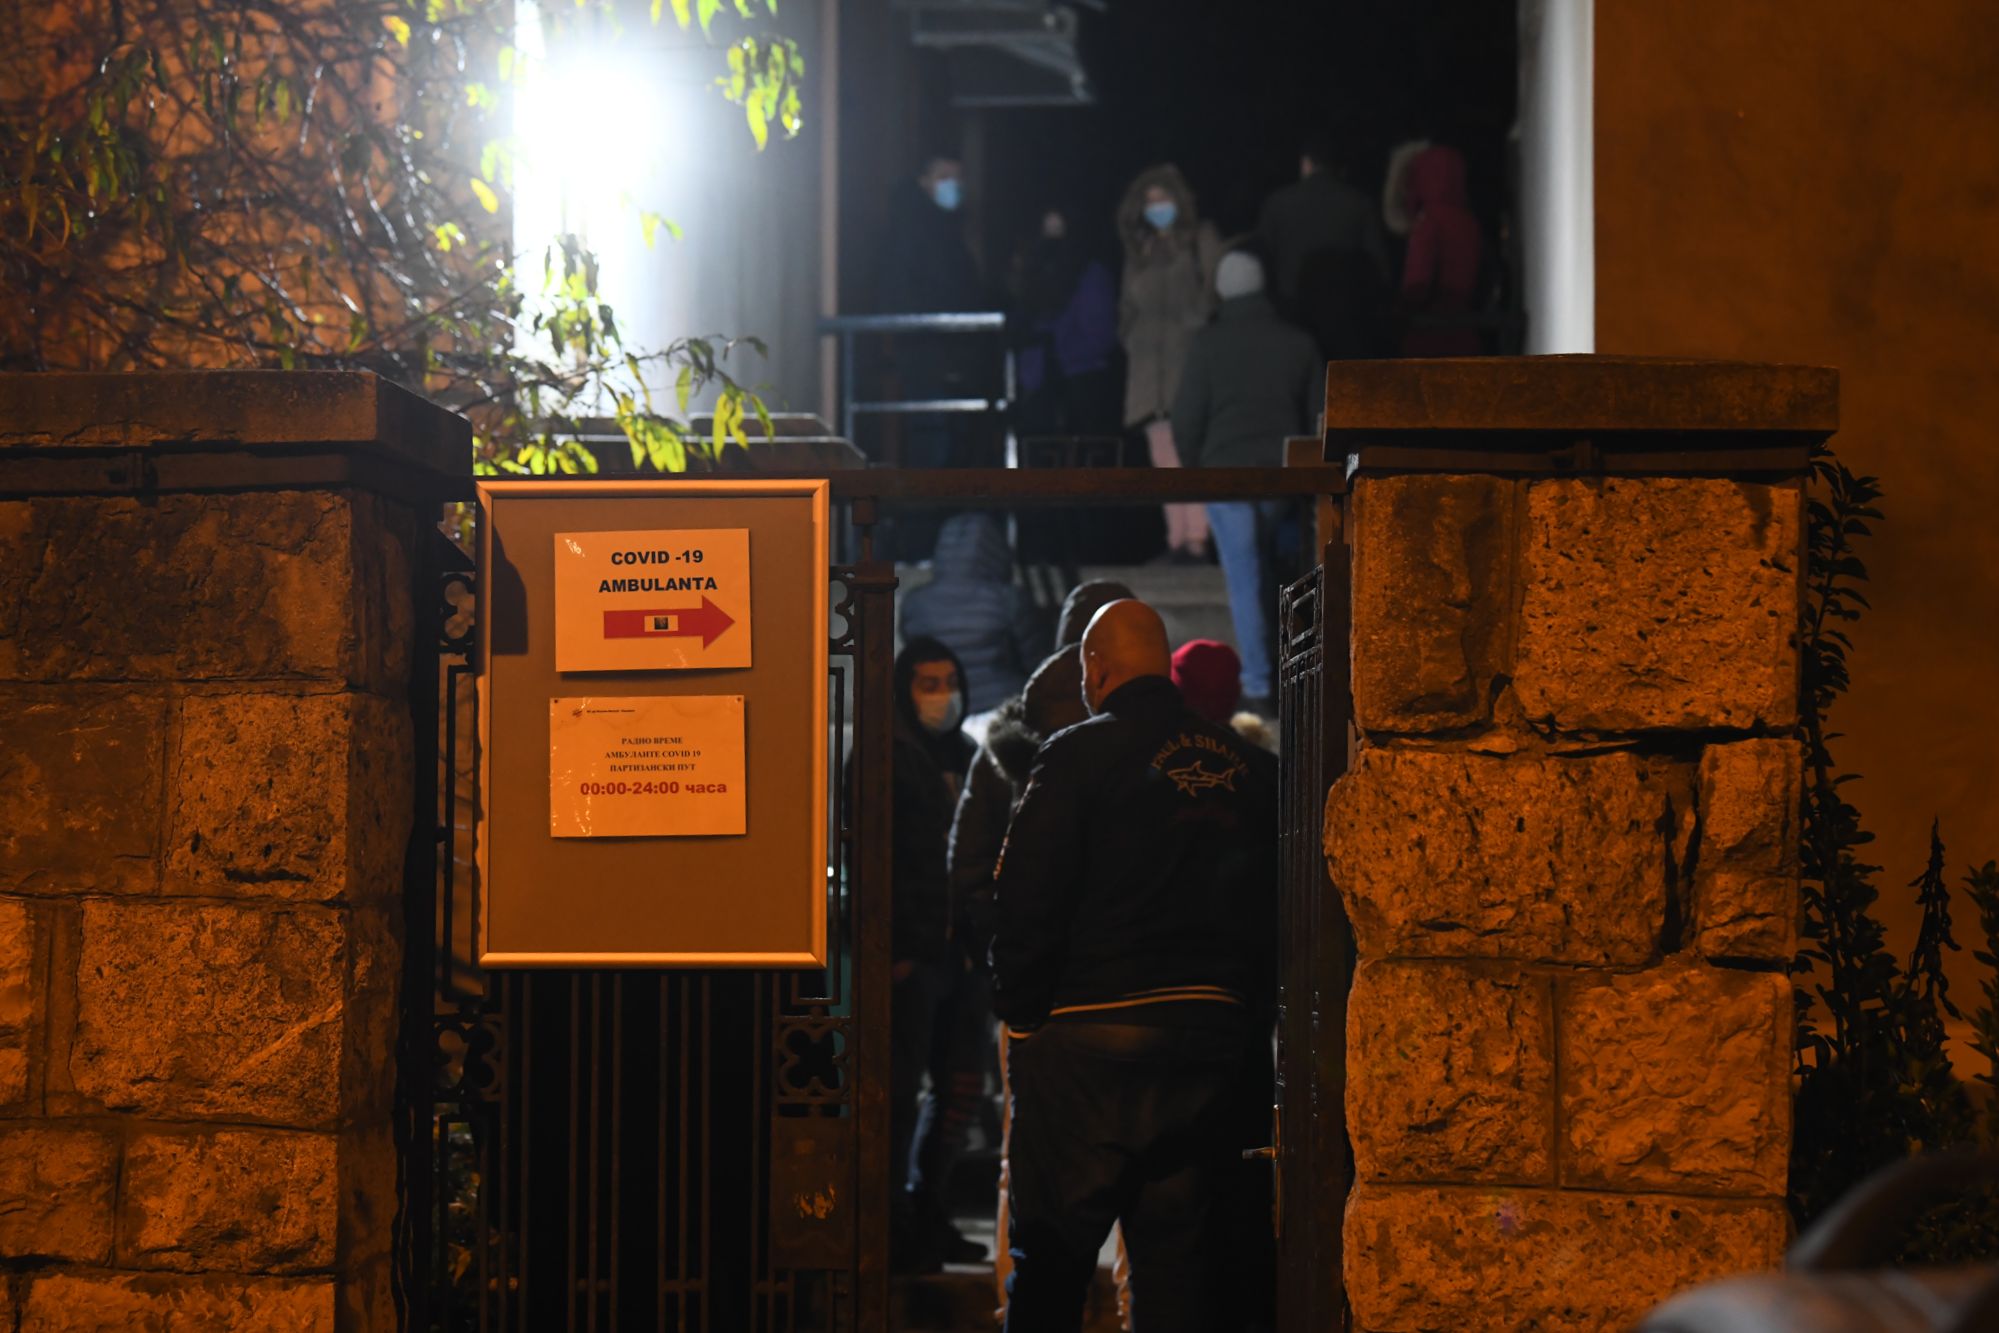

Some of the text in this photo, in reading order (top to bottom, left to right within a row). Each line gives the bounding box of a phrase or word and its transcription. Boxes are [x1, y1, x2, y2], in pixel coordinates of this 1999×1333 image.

[611, 550, 704, 566] COVID -19
[598, 576, 718, 593] AMBULANTA
[653, 737, 683, 747] ВРЕМЕ
[605, 750, 701, 760] АМБУЛАНТЕ COVID 19
[609, 763, 697, 773] ПАРТИЗАНСКИ ПУТ
[580, 781, 728, 796] 00:00-24:00 часа
